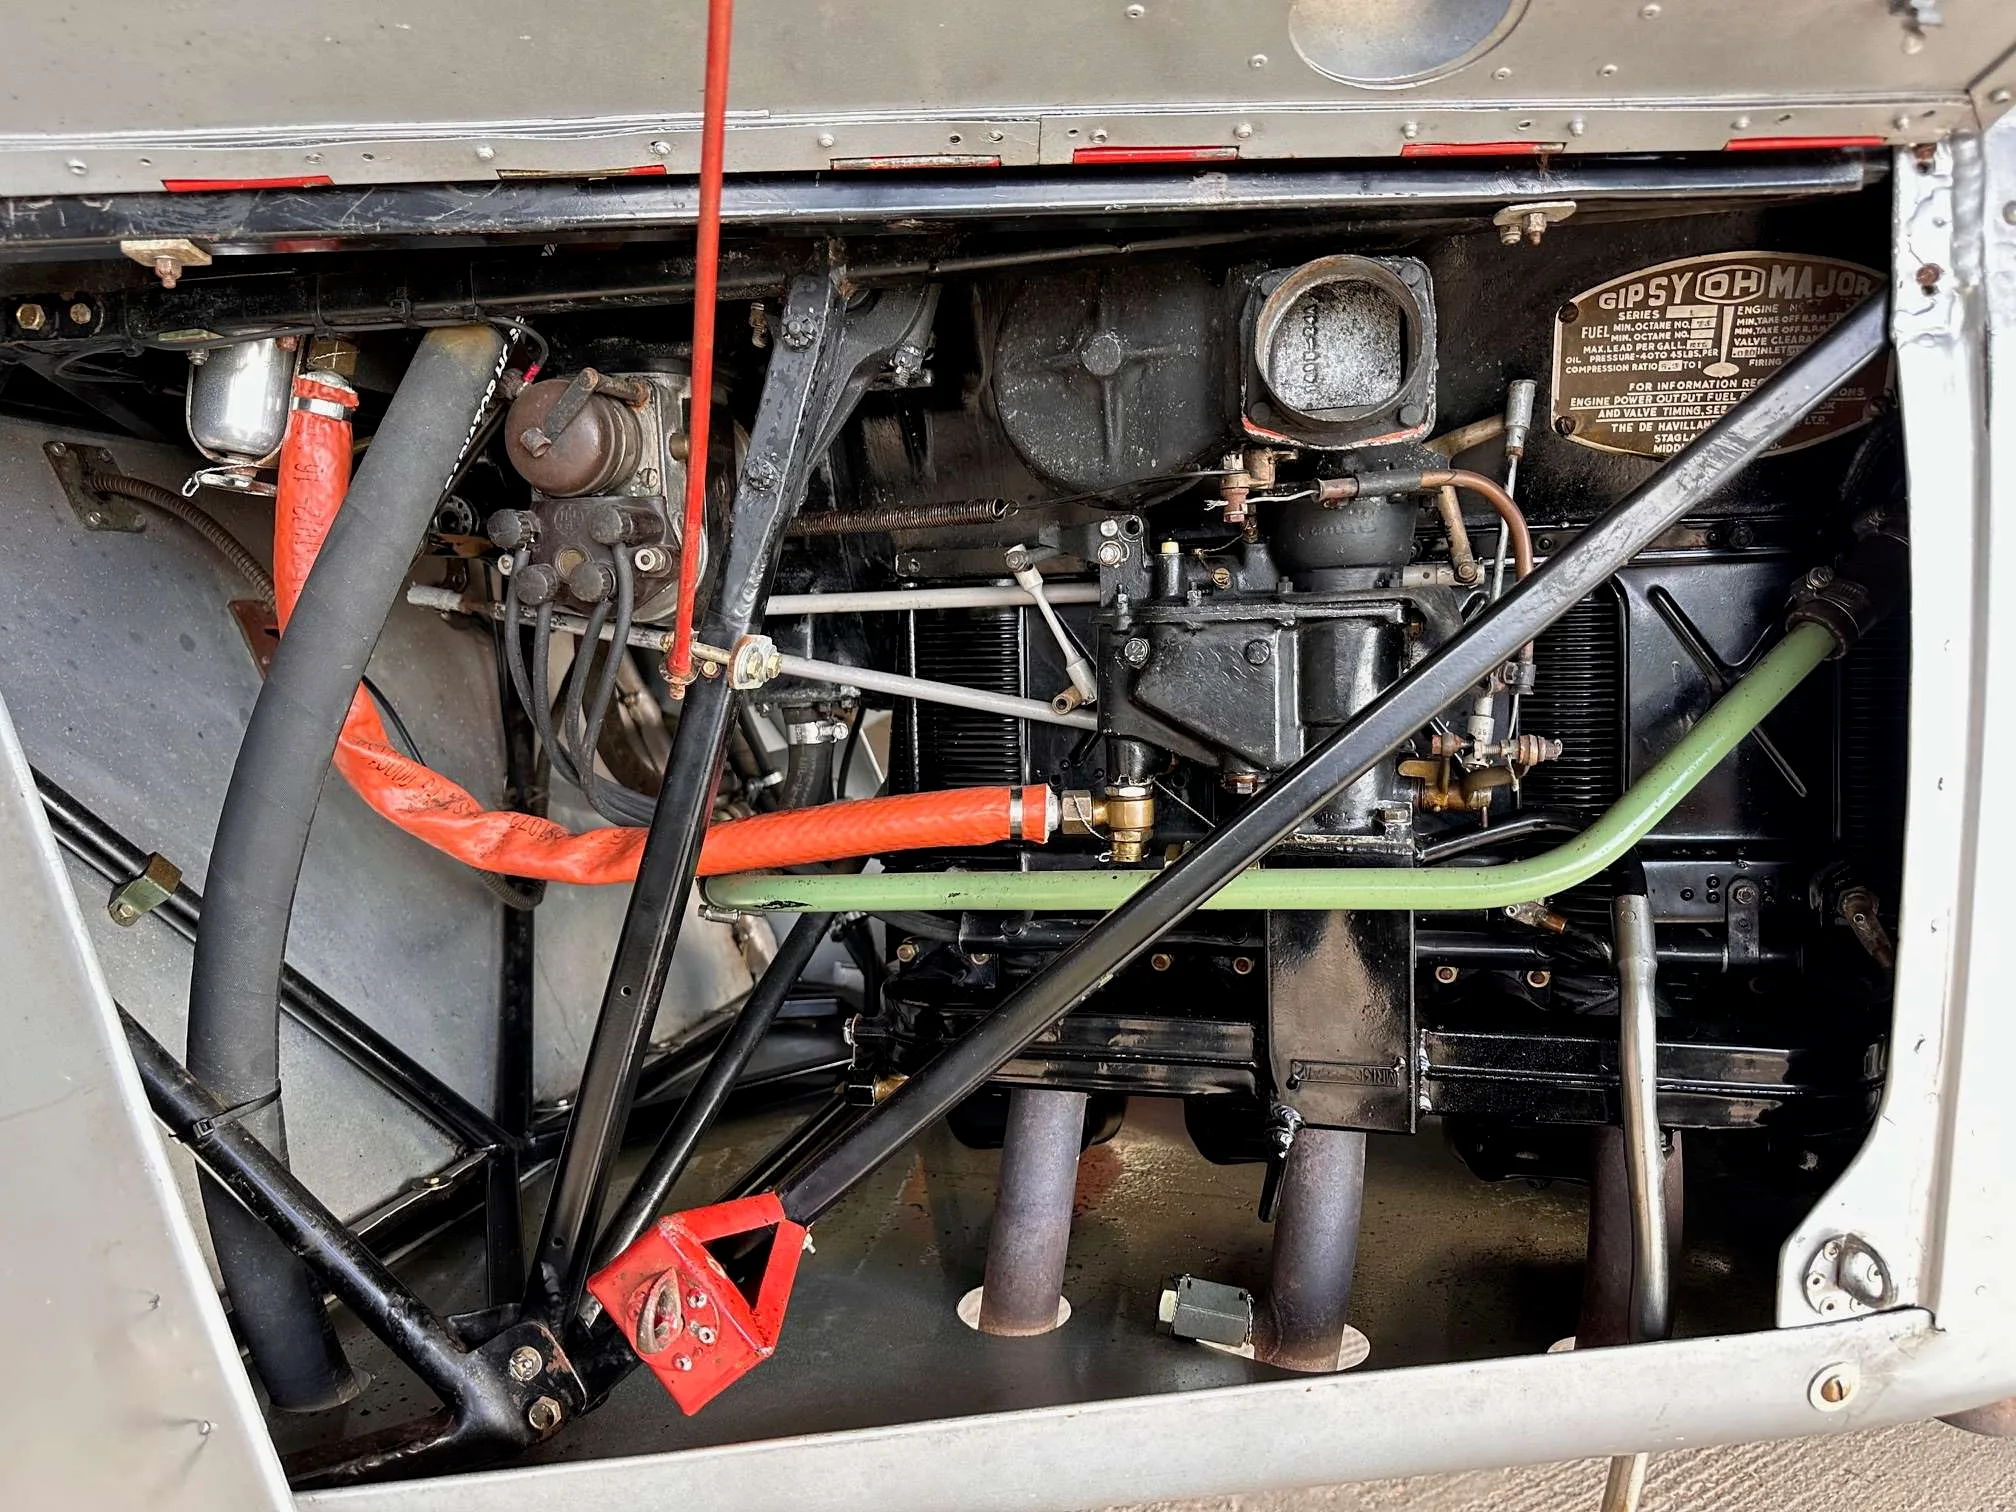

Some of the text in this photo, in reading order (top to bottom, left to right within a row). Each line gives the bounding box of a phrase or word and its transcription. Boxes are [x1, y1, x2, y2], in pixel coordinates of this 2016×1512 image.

[1599, 272, 1694, 310] GIPSY
[1768, 264, 1871, 299] MAJOR
[1737, 304, 1779, 315] ENGINE
[1618, 310, 1660, 321] SERIES
[1781, 314, 1801, 323] OFF
[1581, 326, 1610, 339] FUEL
[1782, 325, 1801, 334] OFF
[1634, 332, 1671, 341] OCTANE
[1733, 337, 1767, 346] VALVE
[1636, 342, 1655, 351] PER
[1657, 342, 1686, 350] GALL.
[1757, 346, 1786, 355] INLET
[1565, 363, 1630, 374] COMPRESSION
[1632, 363, 1657, 371] RATIO
[1683, 361, 1696, 370] TO
[1749, 358, 1782, 367] FIRING
[1629, 382, 1653, 392] FOR
[1657, 379, 1737, 391] INFORMATION
[1570, 396, 1610, 407] ENGINE
[1613, 395, 1652, 405] POWER
[1656, 393, 1703, 404] OUTPUT
[1707, 392, 1737, 402] FUEL
[1598, 409, 1620, 419] AND
[1624, 407, 1657, 417] VALVE
[1611, 423, 1634, 433] THE
[1638, 422, 1653, 432] DE
